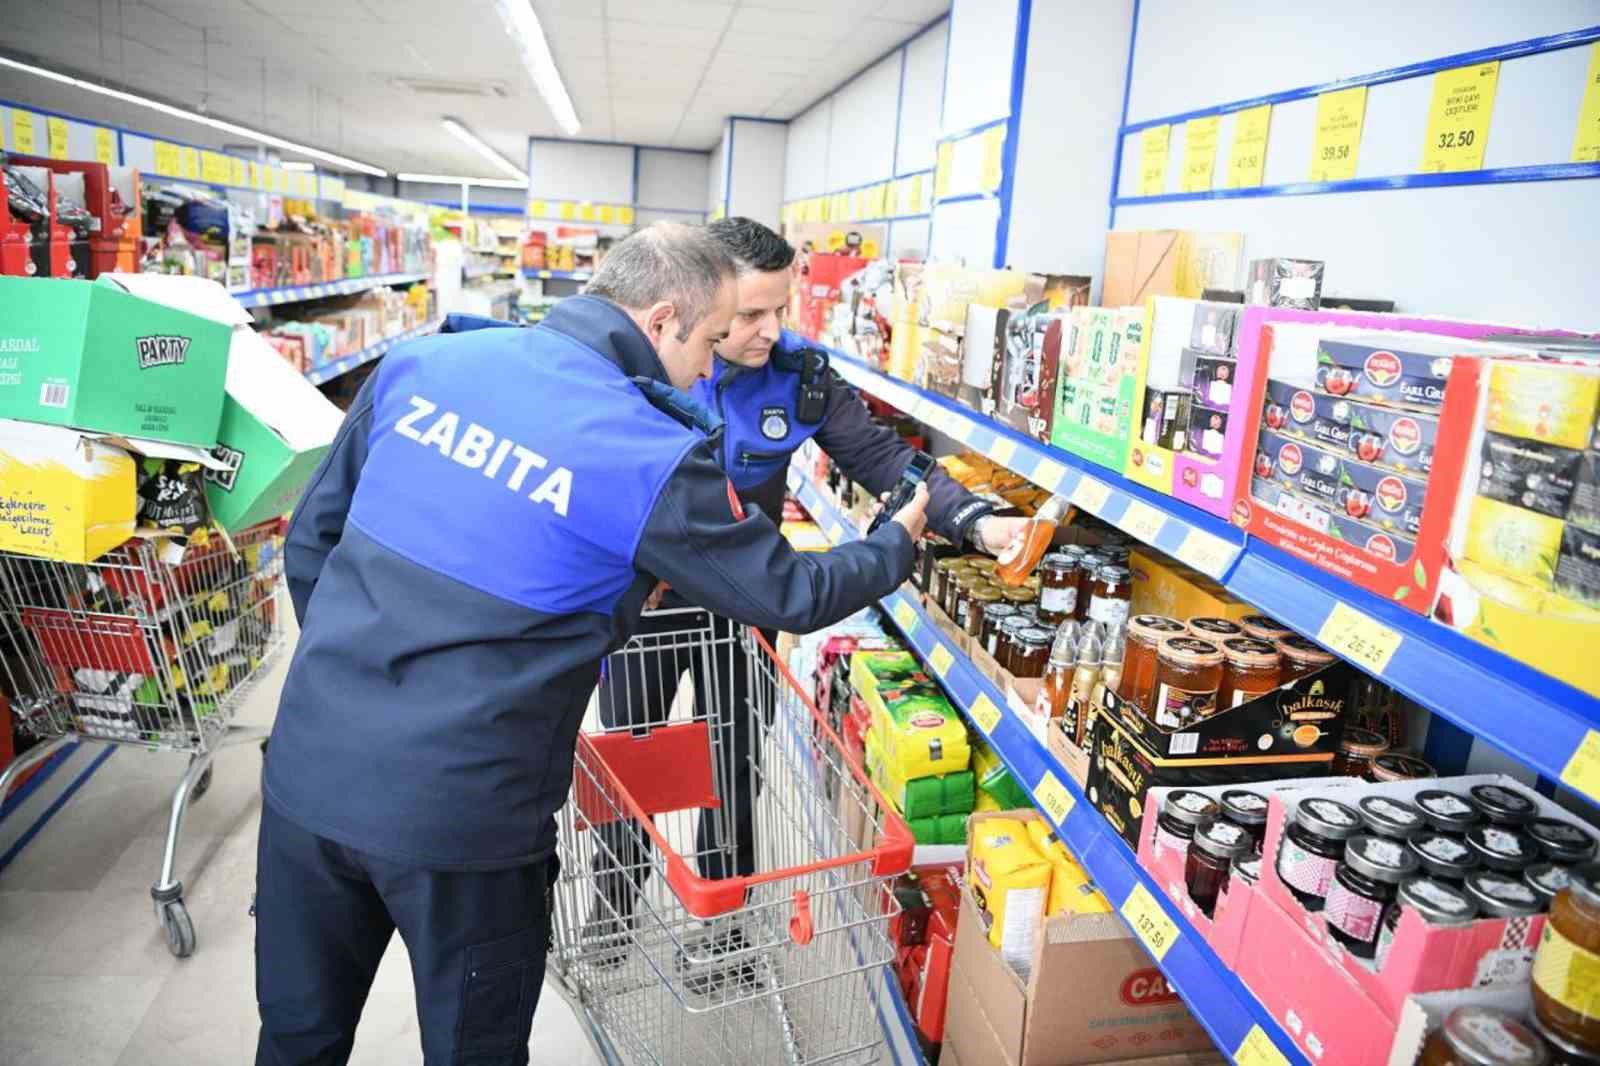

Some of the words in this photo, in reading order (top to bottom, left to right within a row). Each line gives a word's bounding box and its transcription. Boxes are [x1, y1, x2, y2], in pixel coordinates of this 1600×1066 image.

[1438, 130, 1474, 149] 32.50
[139, 338, 187, 363] PARTY
[393, 395, 574, 518] ZABITA
[1138, 913, 1165, 949] 137.50
[1130, 976, 1177, 999] CA
